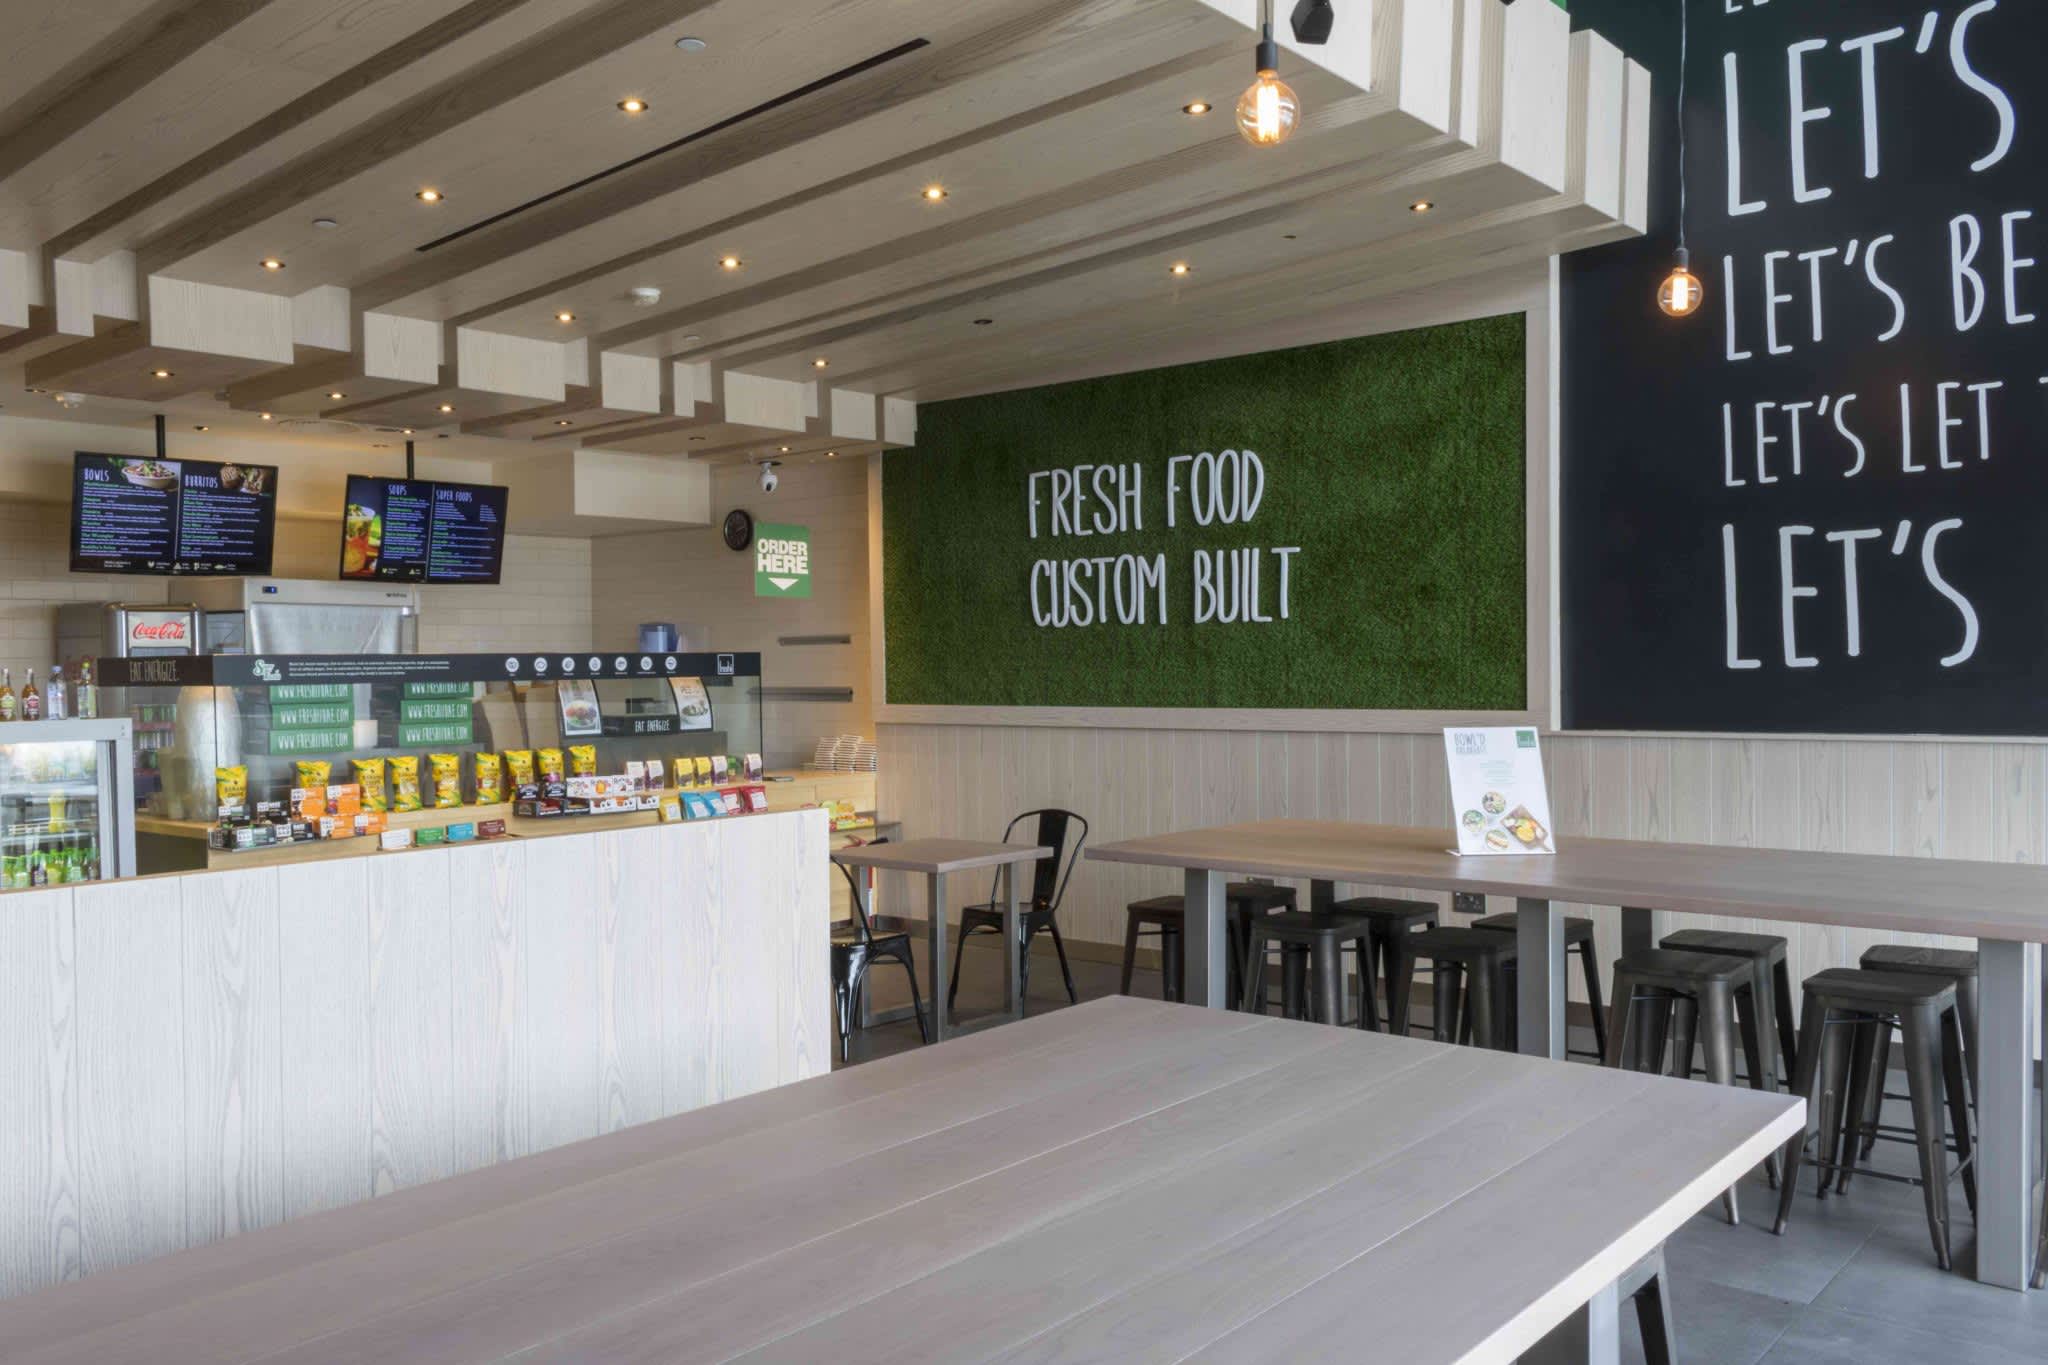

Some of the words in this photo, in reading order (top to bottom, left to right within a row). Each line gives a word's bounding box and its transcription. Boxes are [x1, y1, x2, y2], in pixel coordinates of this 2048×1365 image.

[1723, 0, 2015, 216] LET'S
[1723, 234, 1905, 361] LET'S
[1949, 211, 2035, 331] BE
[83, 467, 110, 482] BOWLS
[1723, 394, 1865, 486] LET'S
[1900, 381, 2003, 472] LET
[184, 474, 219, 489] BURRITOS
[387, 484, 408, 496] SOUPS
[1028, 462, 1143, 538] FRESH
[1167, 449, 1264, 528] FOOD
[757, 538, 808, 556] ORDER
[757, 553, 809, 575] HERE
[1030, 553, 1167, 628] CUSTOM
[1193, 546, 1301, 625] BUILT
[1722, 518, 1980, 669] LET'S
